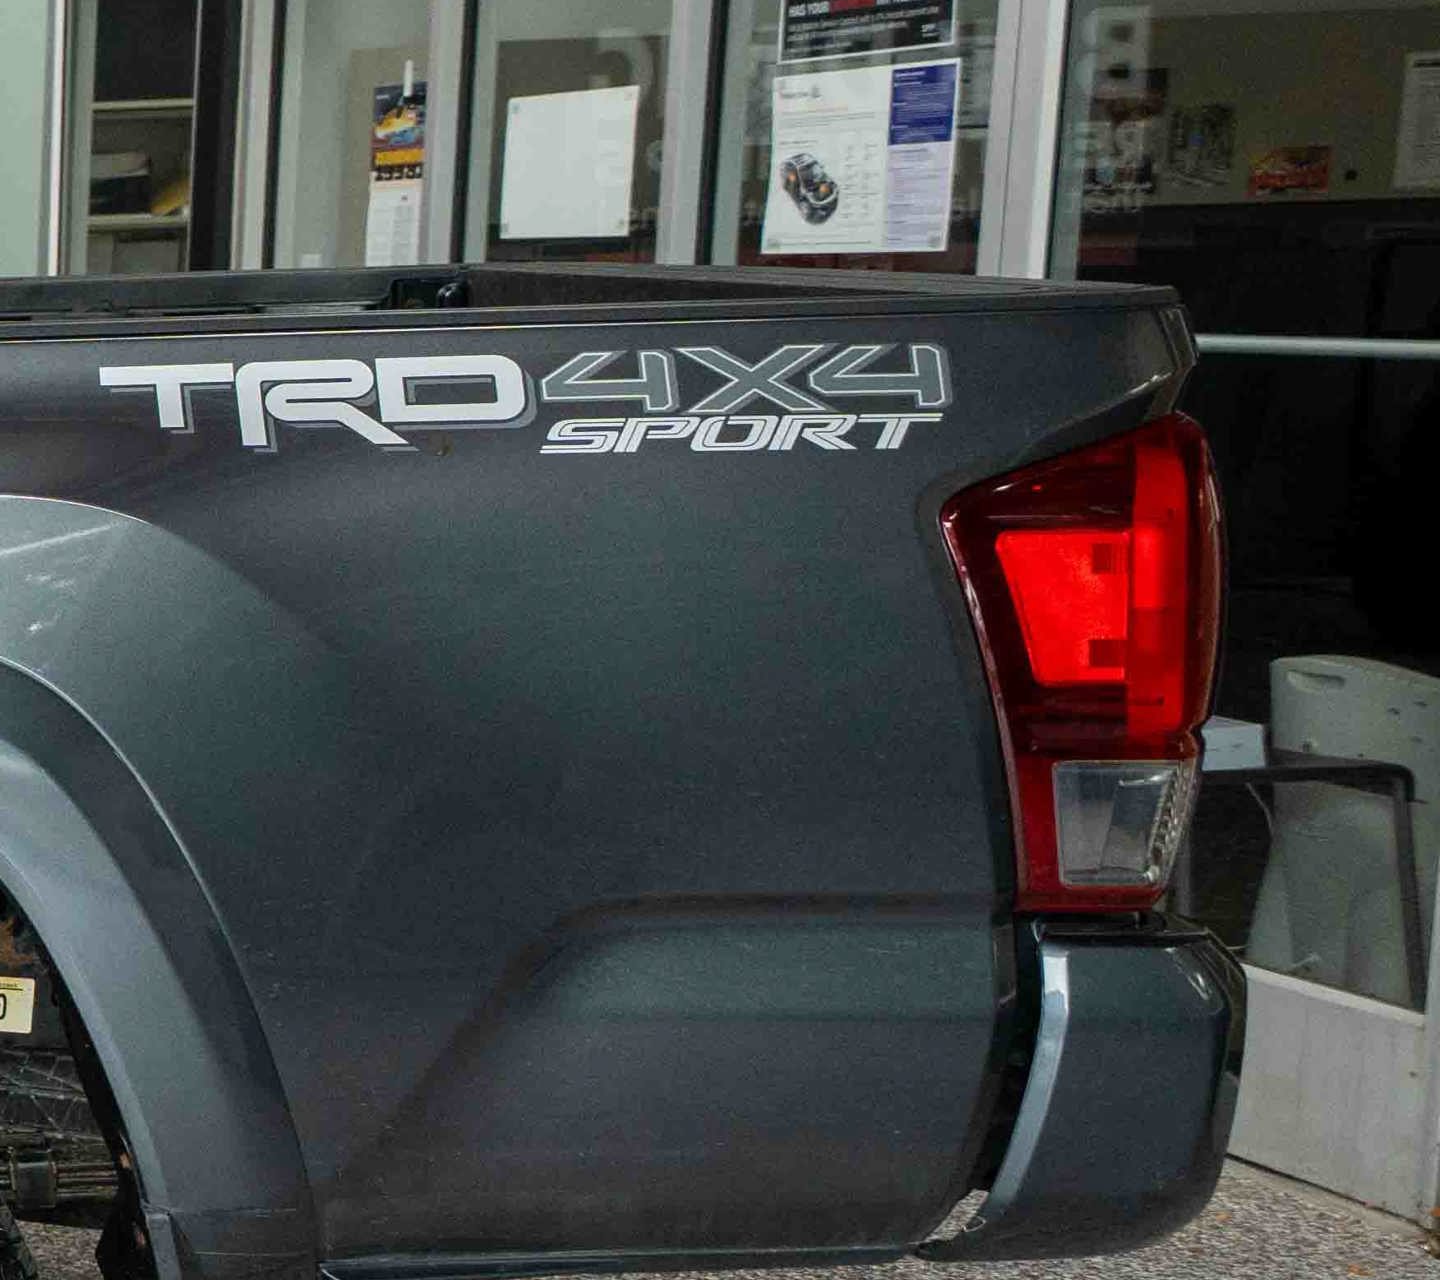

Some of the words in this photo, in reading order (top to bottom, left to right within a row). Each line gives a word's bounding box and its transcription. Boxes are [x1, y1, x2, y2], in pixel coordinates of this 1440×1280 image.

[98, 353, 537, 454] TRD
[538, 342, 952, 414] 4X4
[538, 411, 944, 455] SPORT
